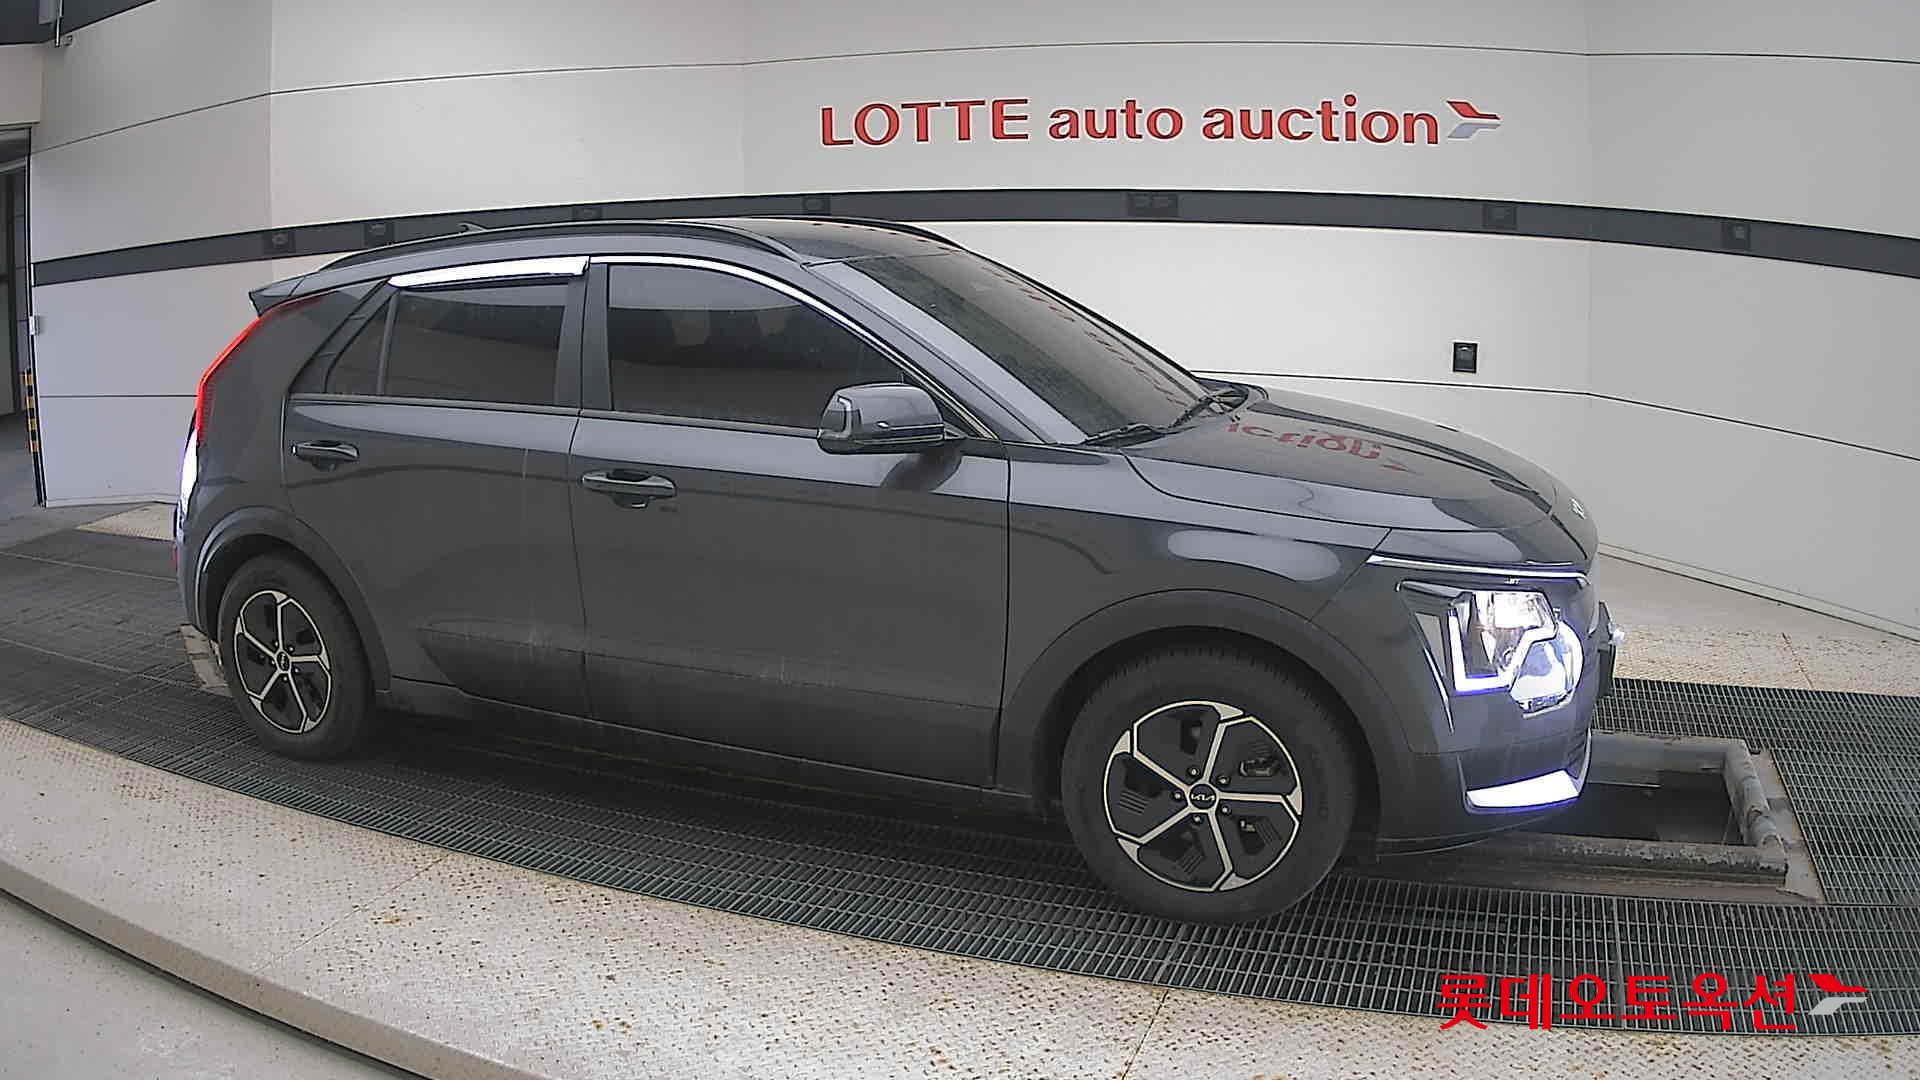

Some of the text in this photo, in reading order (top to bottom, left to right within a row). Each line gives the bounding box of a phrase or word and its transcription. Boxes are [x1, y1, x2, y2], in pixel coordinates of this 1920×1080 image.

[820, 94, 1440, 146] LOTTE auto auction
